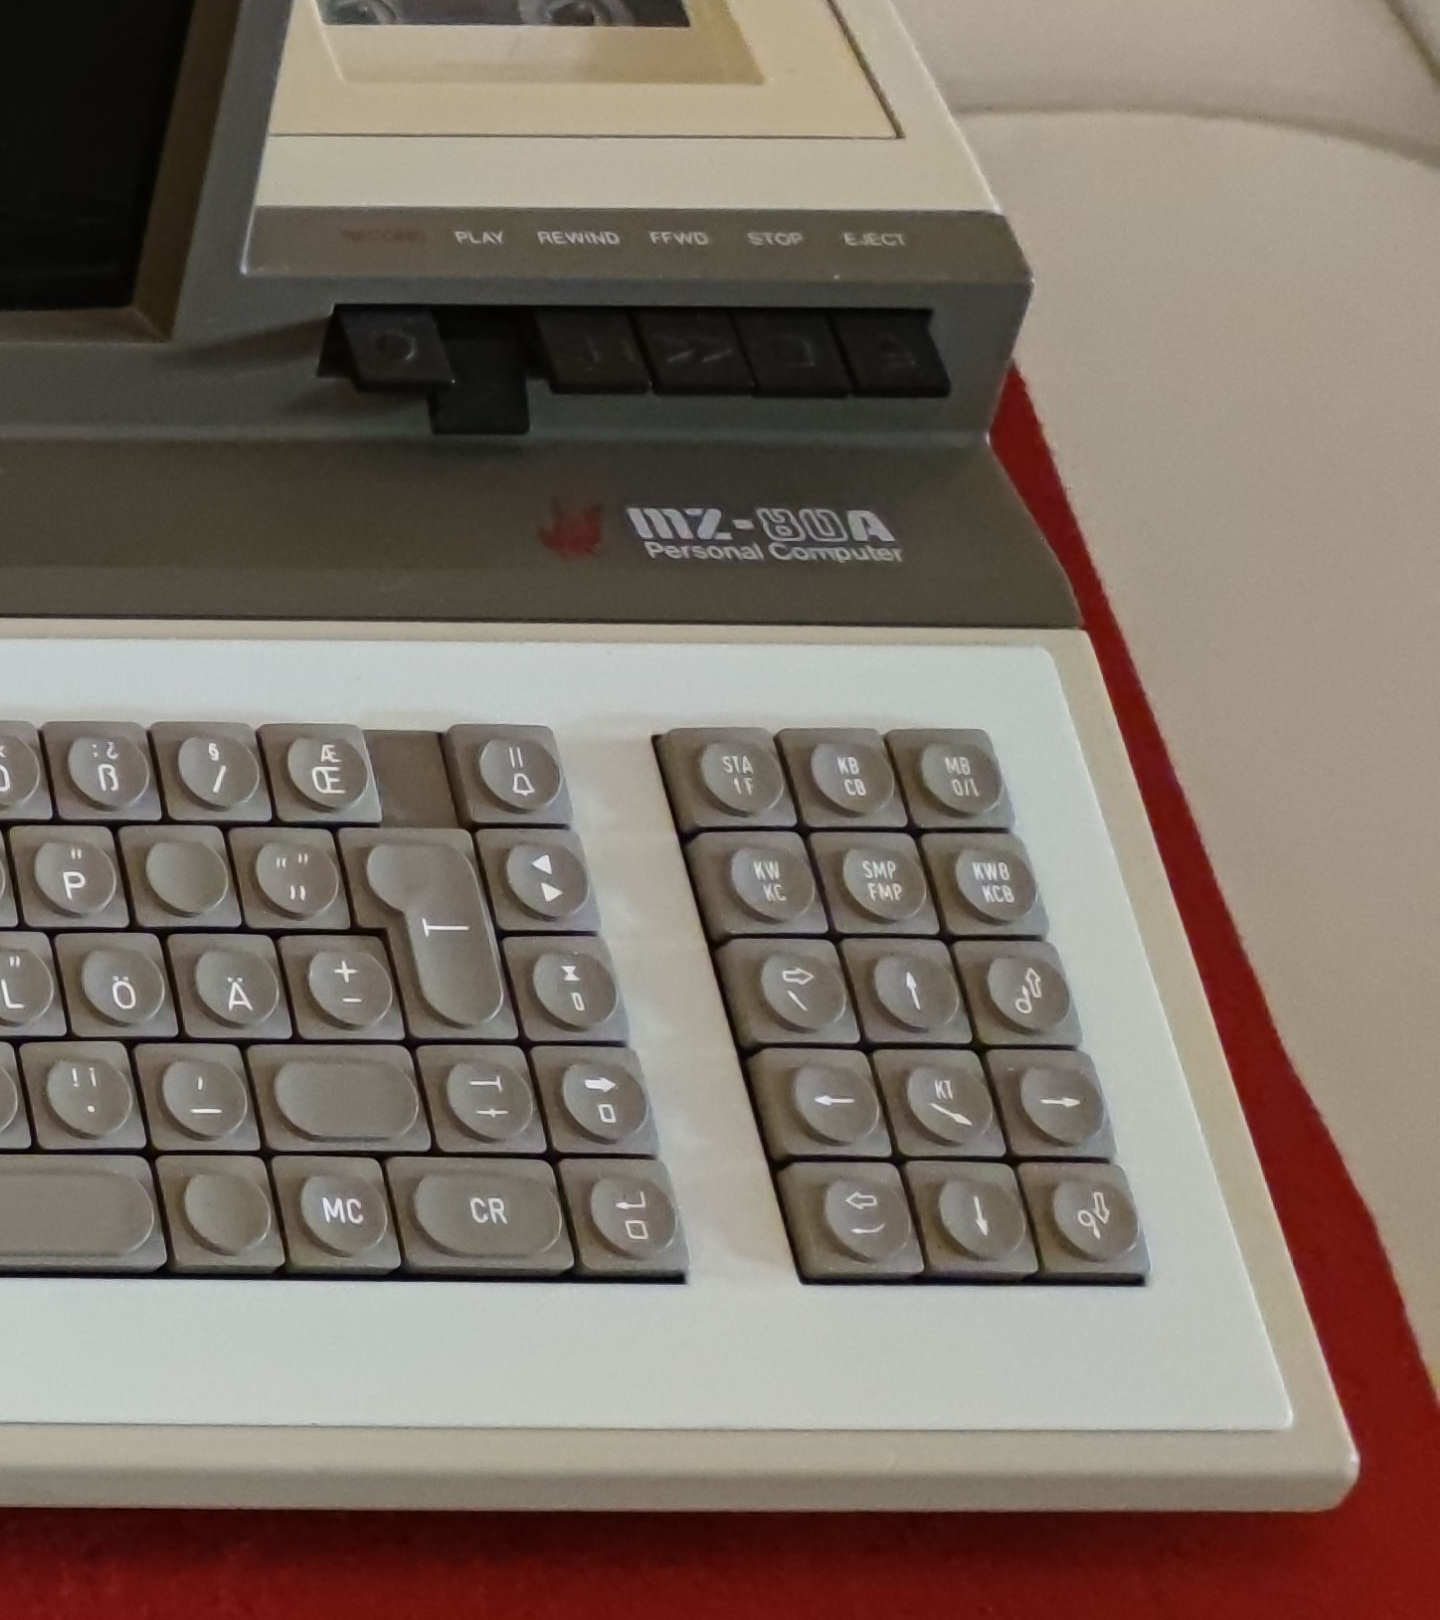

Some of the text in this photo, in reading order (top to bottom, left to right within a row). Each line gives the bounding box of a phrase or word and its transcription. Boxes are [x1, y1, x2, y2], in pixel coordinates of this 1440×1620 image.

[454, 231, 504, 244] PLAY
[537, 231, 620, 245] REWIND
[649, 231, 709, 246] FFWD
[746, 231, 803, 246] STOP
[842, 231, 908, 247] EJECT
[643, 541, 903, 563] Personal Computer
[721, 755, 755, 775] STA
[836, 756, 862, 776] KB
[944, 756, 972, 776] MB
[844, 777, 868, 797] CB
[752, 861, 781, 879] KW
[861, 860, 897, 879] SMP
[972, 861, 1011, 881] KWB
[63, 871, 87, 901] P
[761, 884, 787, 903] KC
[868, 883, 903, 903] FMP
[981, 884, 1016, 905] KCB
[933, 1079, 955, 1101] KT
[321, 1196, 365, 1225] MC
[469, 1197, 509, 1225] CR
